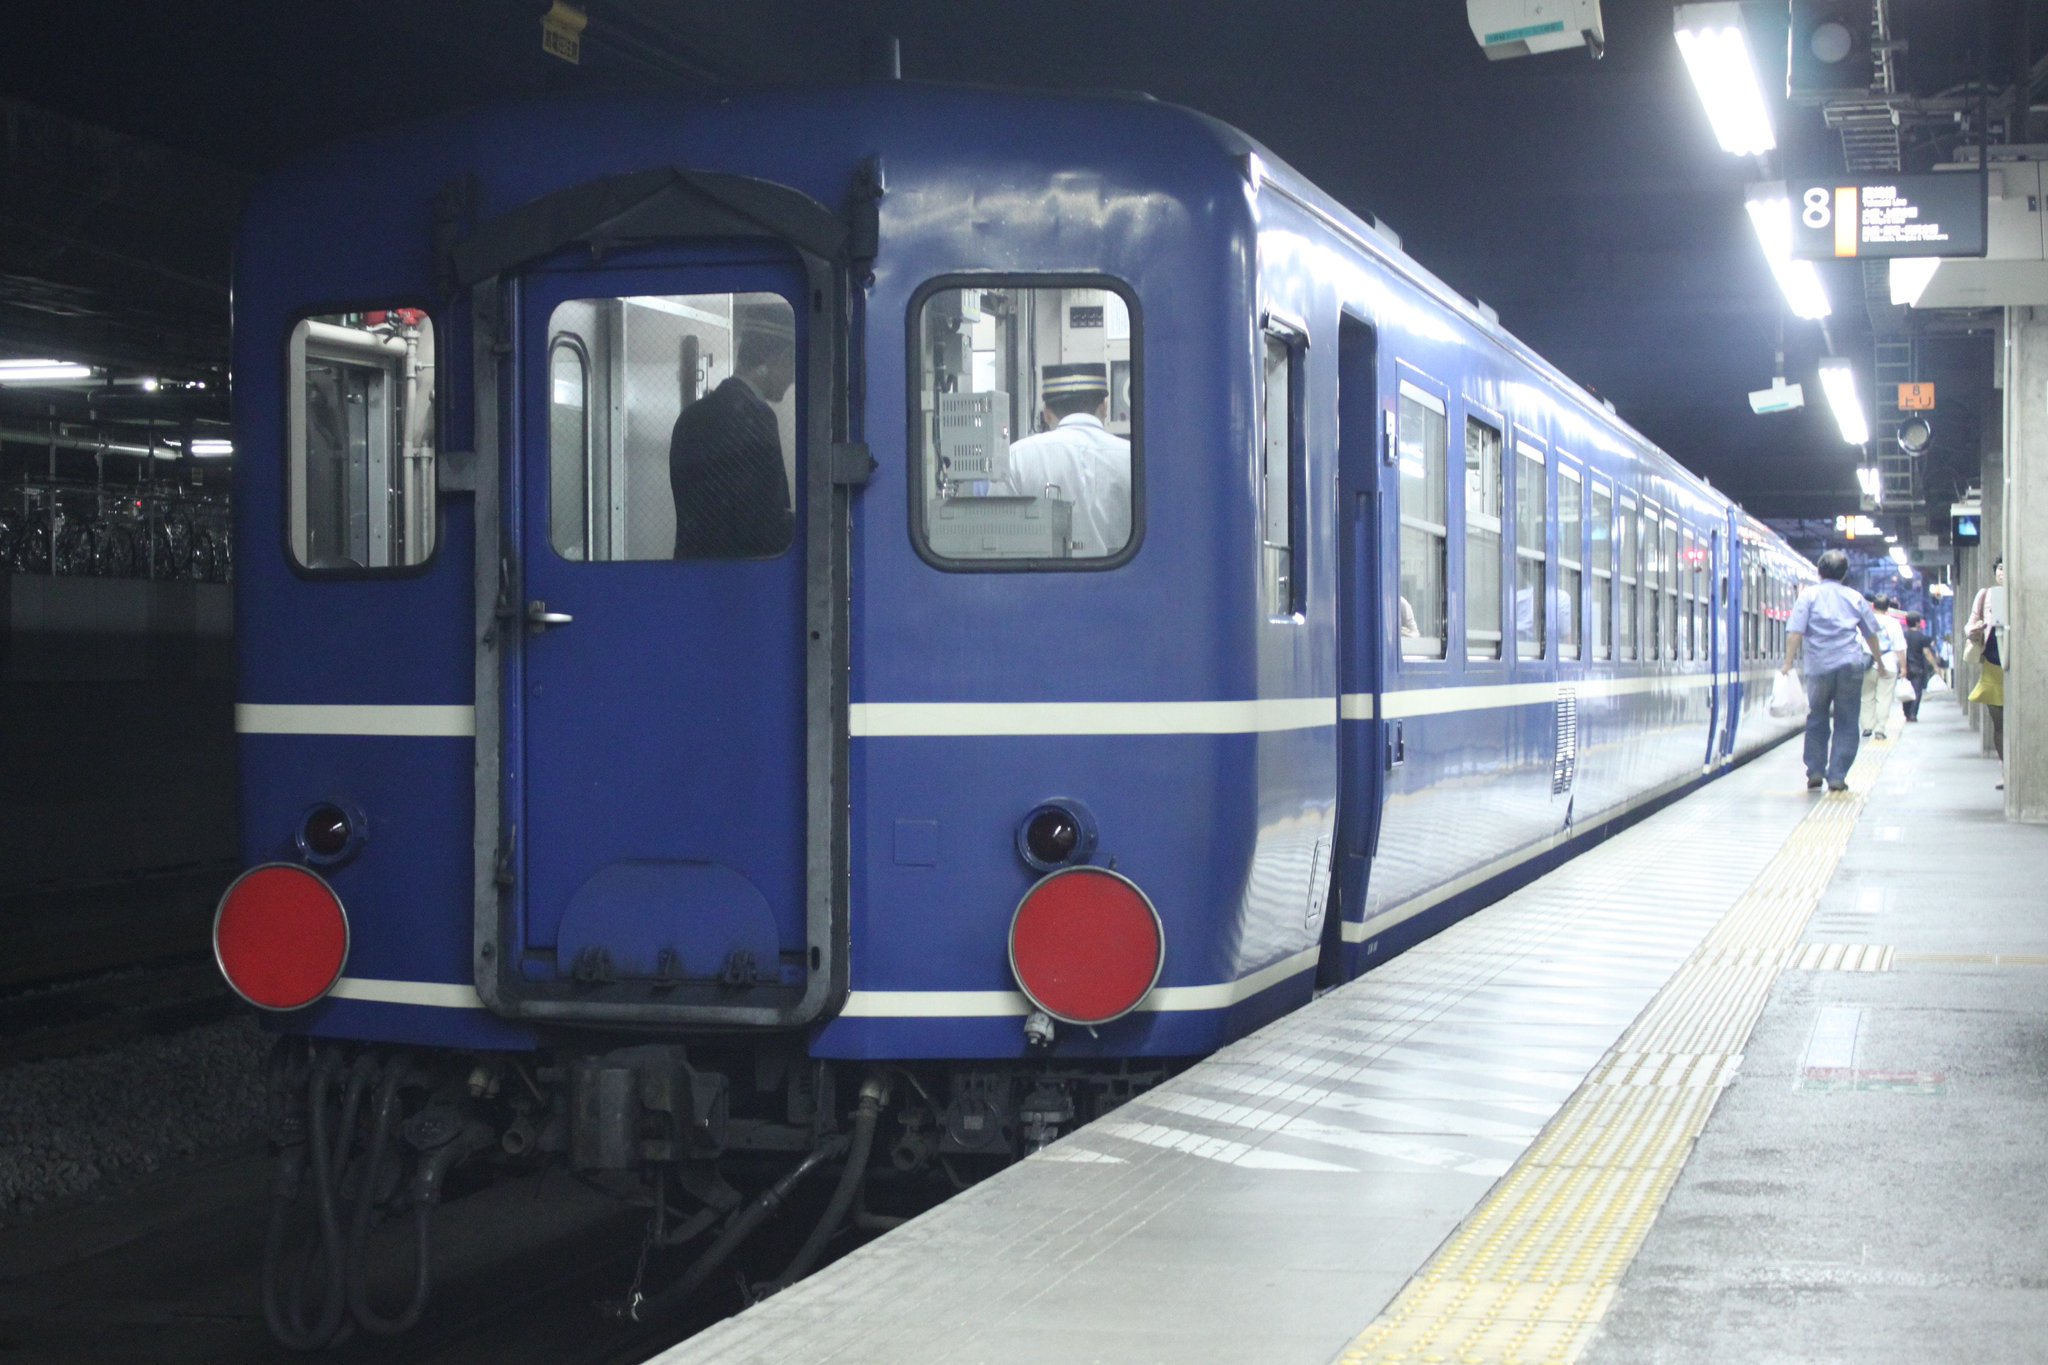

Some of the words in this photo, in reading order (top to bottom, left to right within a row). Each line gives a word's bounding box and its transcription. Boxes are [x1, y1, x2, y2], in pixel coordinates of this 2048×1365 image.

[1803, 187, 1831, 229] 8
[1912, 384, 1920, 396] 8
[1836, 515, 1846, 531] 8
